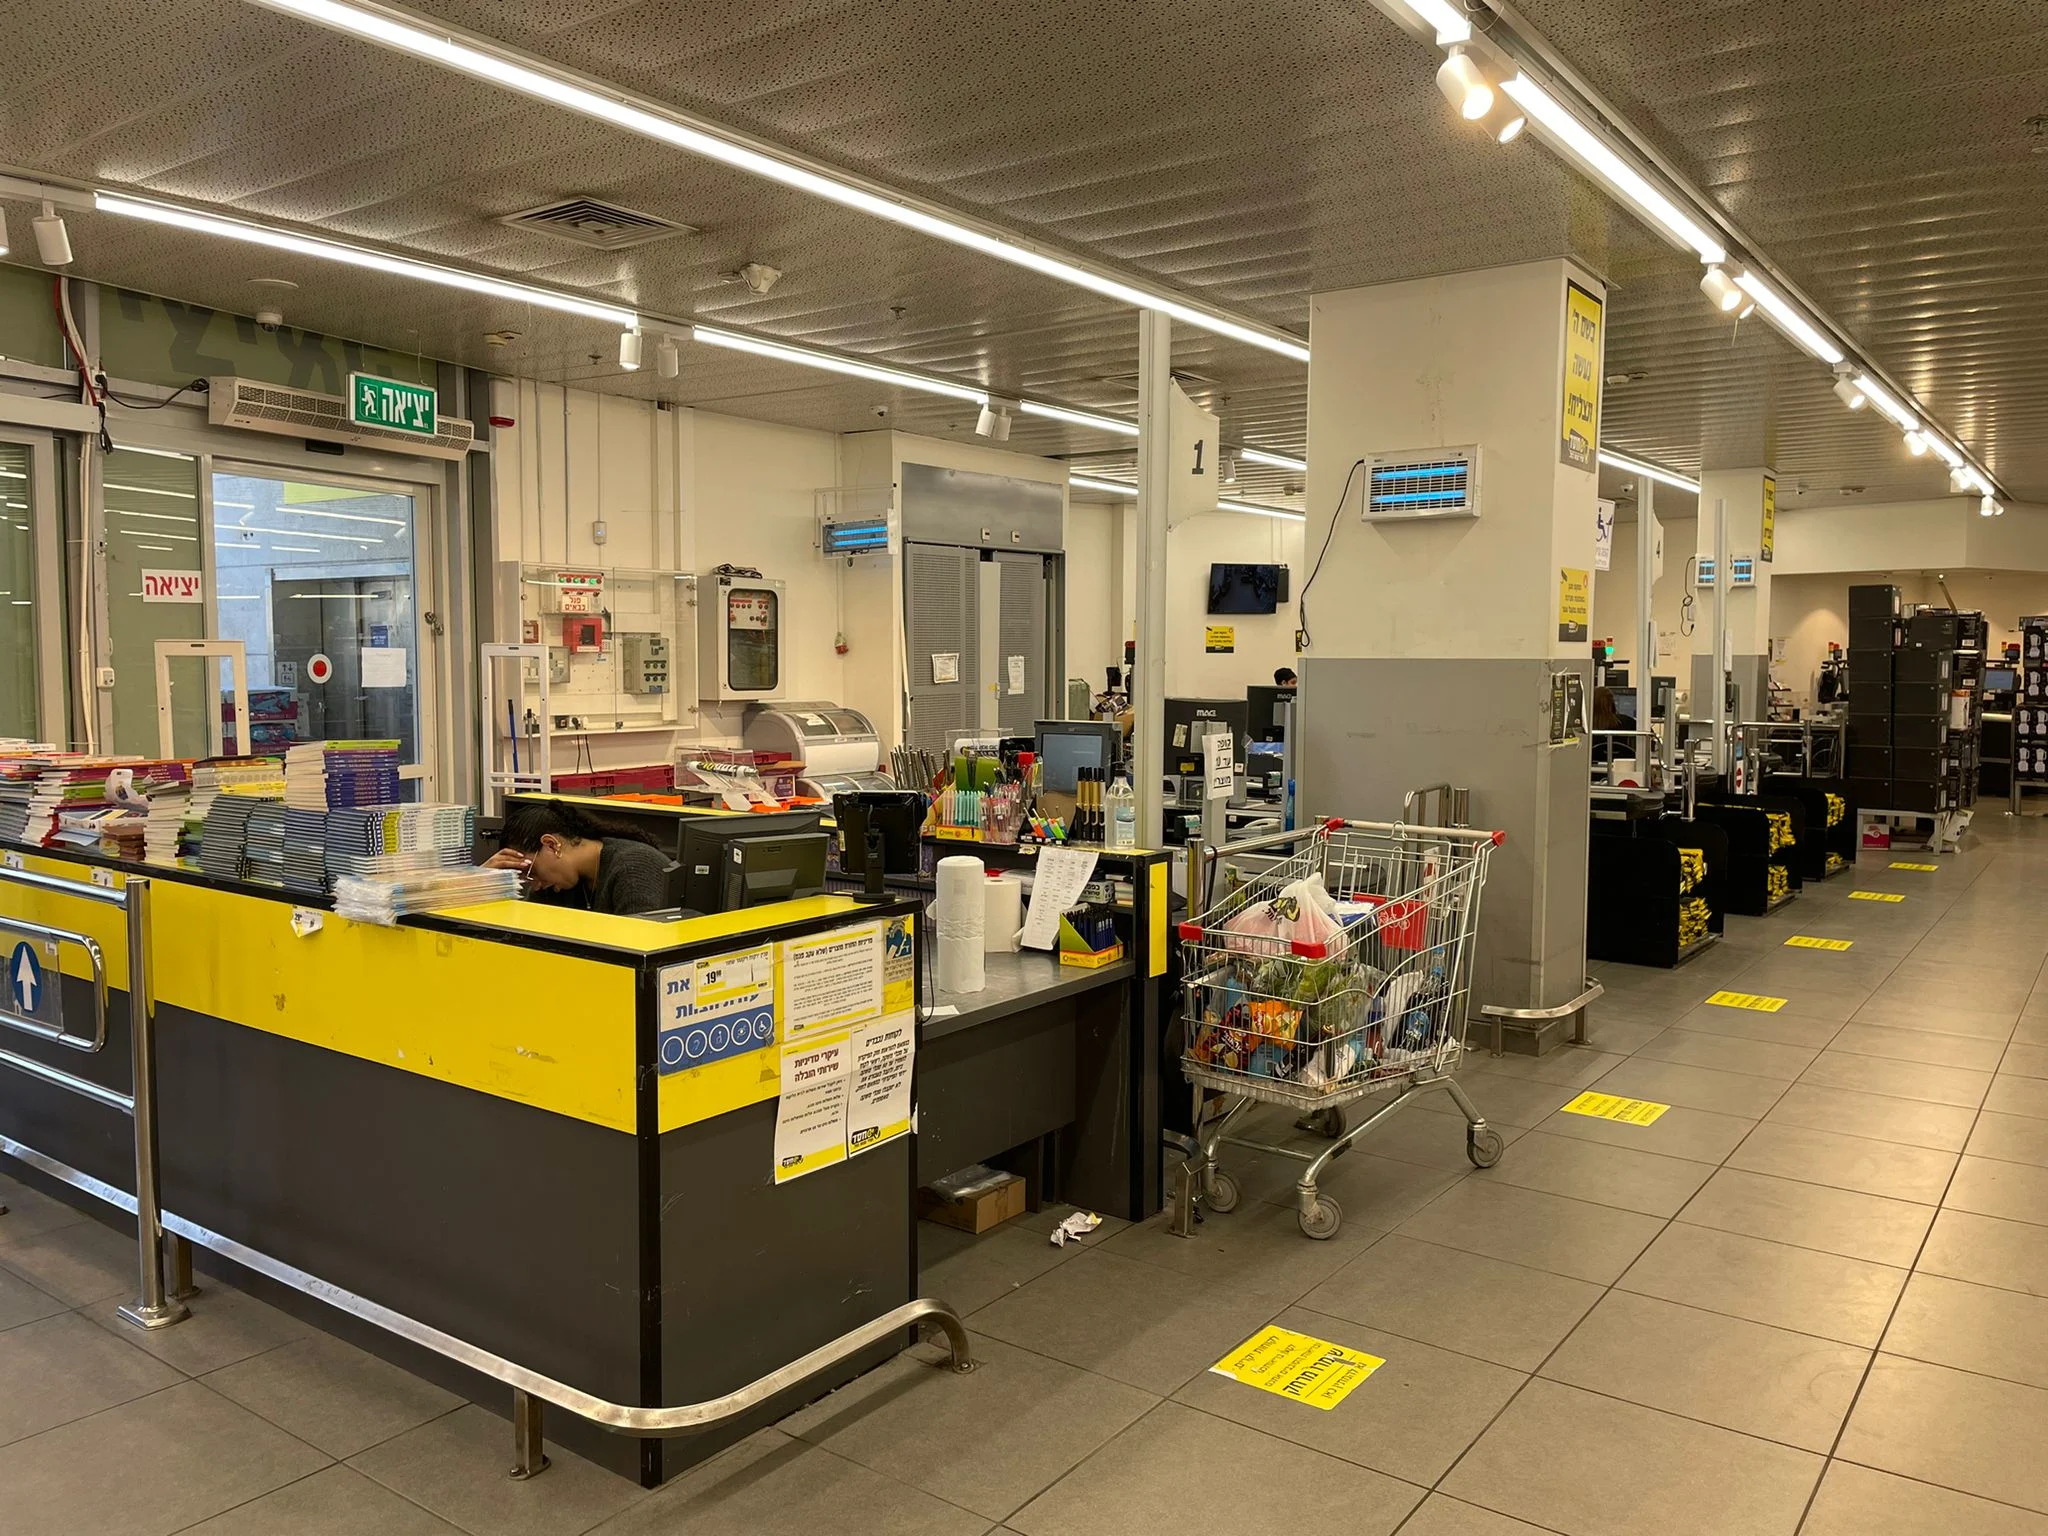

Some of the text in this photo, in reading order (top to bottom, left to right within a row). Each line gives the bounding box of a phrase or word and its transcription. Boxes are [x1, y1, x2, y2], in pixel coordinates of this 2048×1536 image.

[382, 387, 429, 427] יציאה
[1192, 440, 1204, 474] 1
[146, 576, 198, 596] יציאה
[667, 978, 690, 994] את
[794, 1048, 839, 1068] עיקרי מדיניות
[795, 1062, 839, 1082] שירותי הובלה
[1254, 1336, 1280, 1354] לקוחות
[1283, 1348, 1344, 1396] שמרו מרחק
